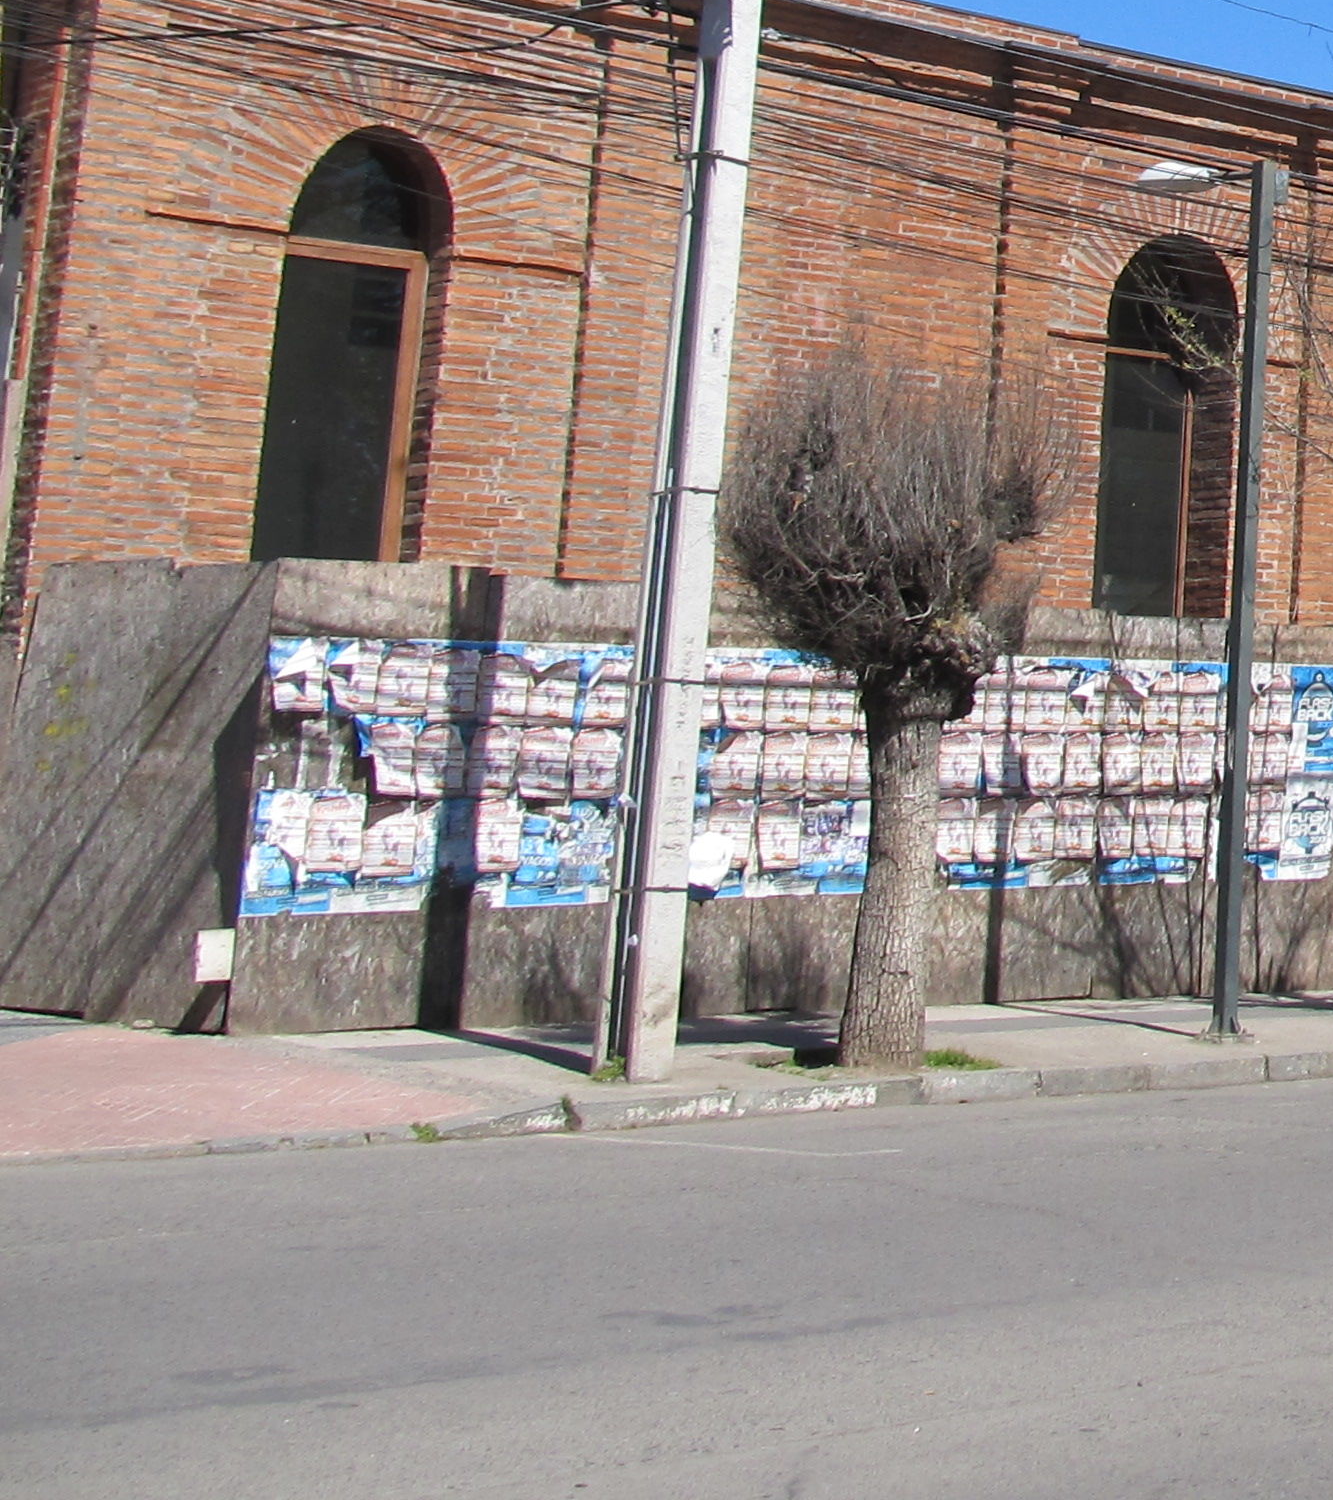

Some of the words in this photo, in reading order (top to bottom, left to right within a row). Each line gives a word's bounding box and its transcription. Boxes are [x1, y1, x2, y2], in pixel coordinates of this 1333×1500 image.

[1297, 708, 1333, 721] BACK
[1290, 811, 1331, 824] FLASH
[1289, 822, 1328, 837] BACK
